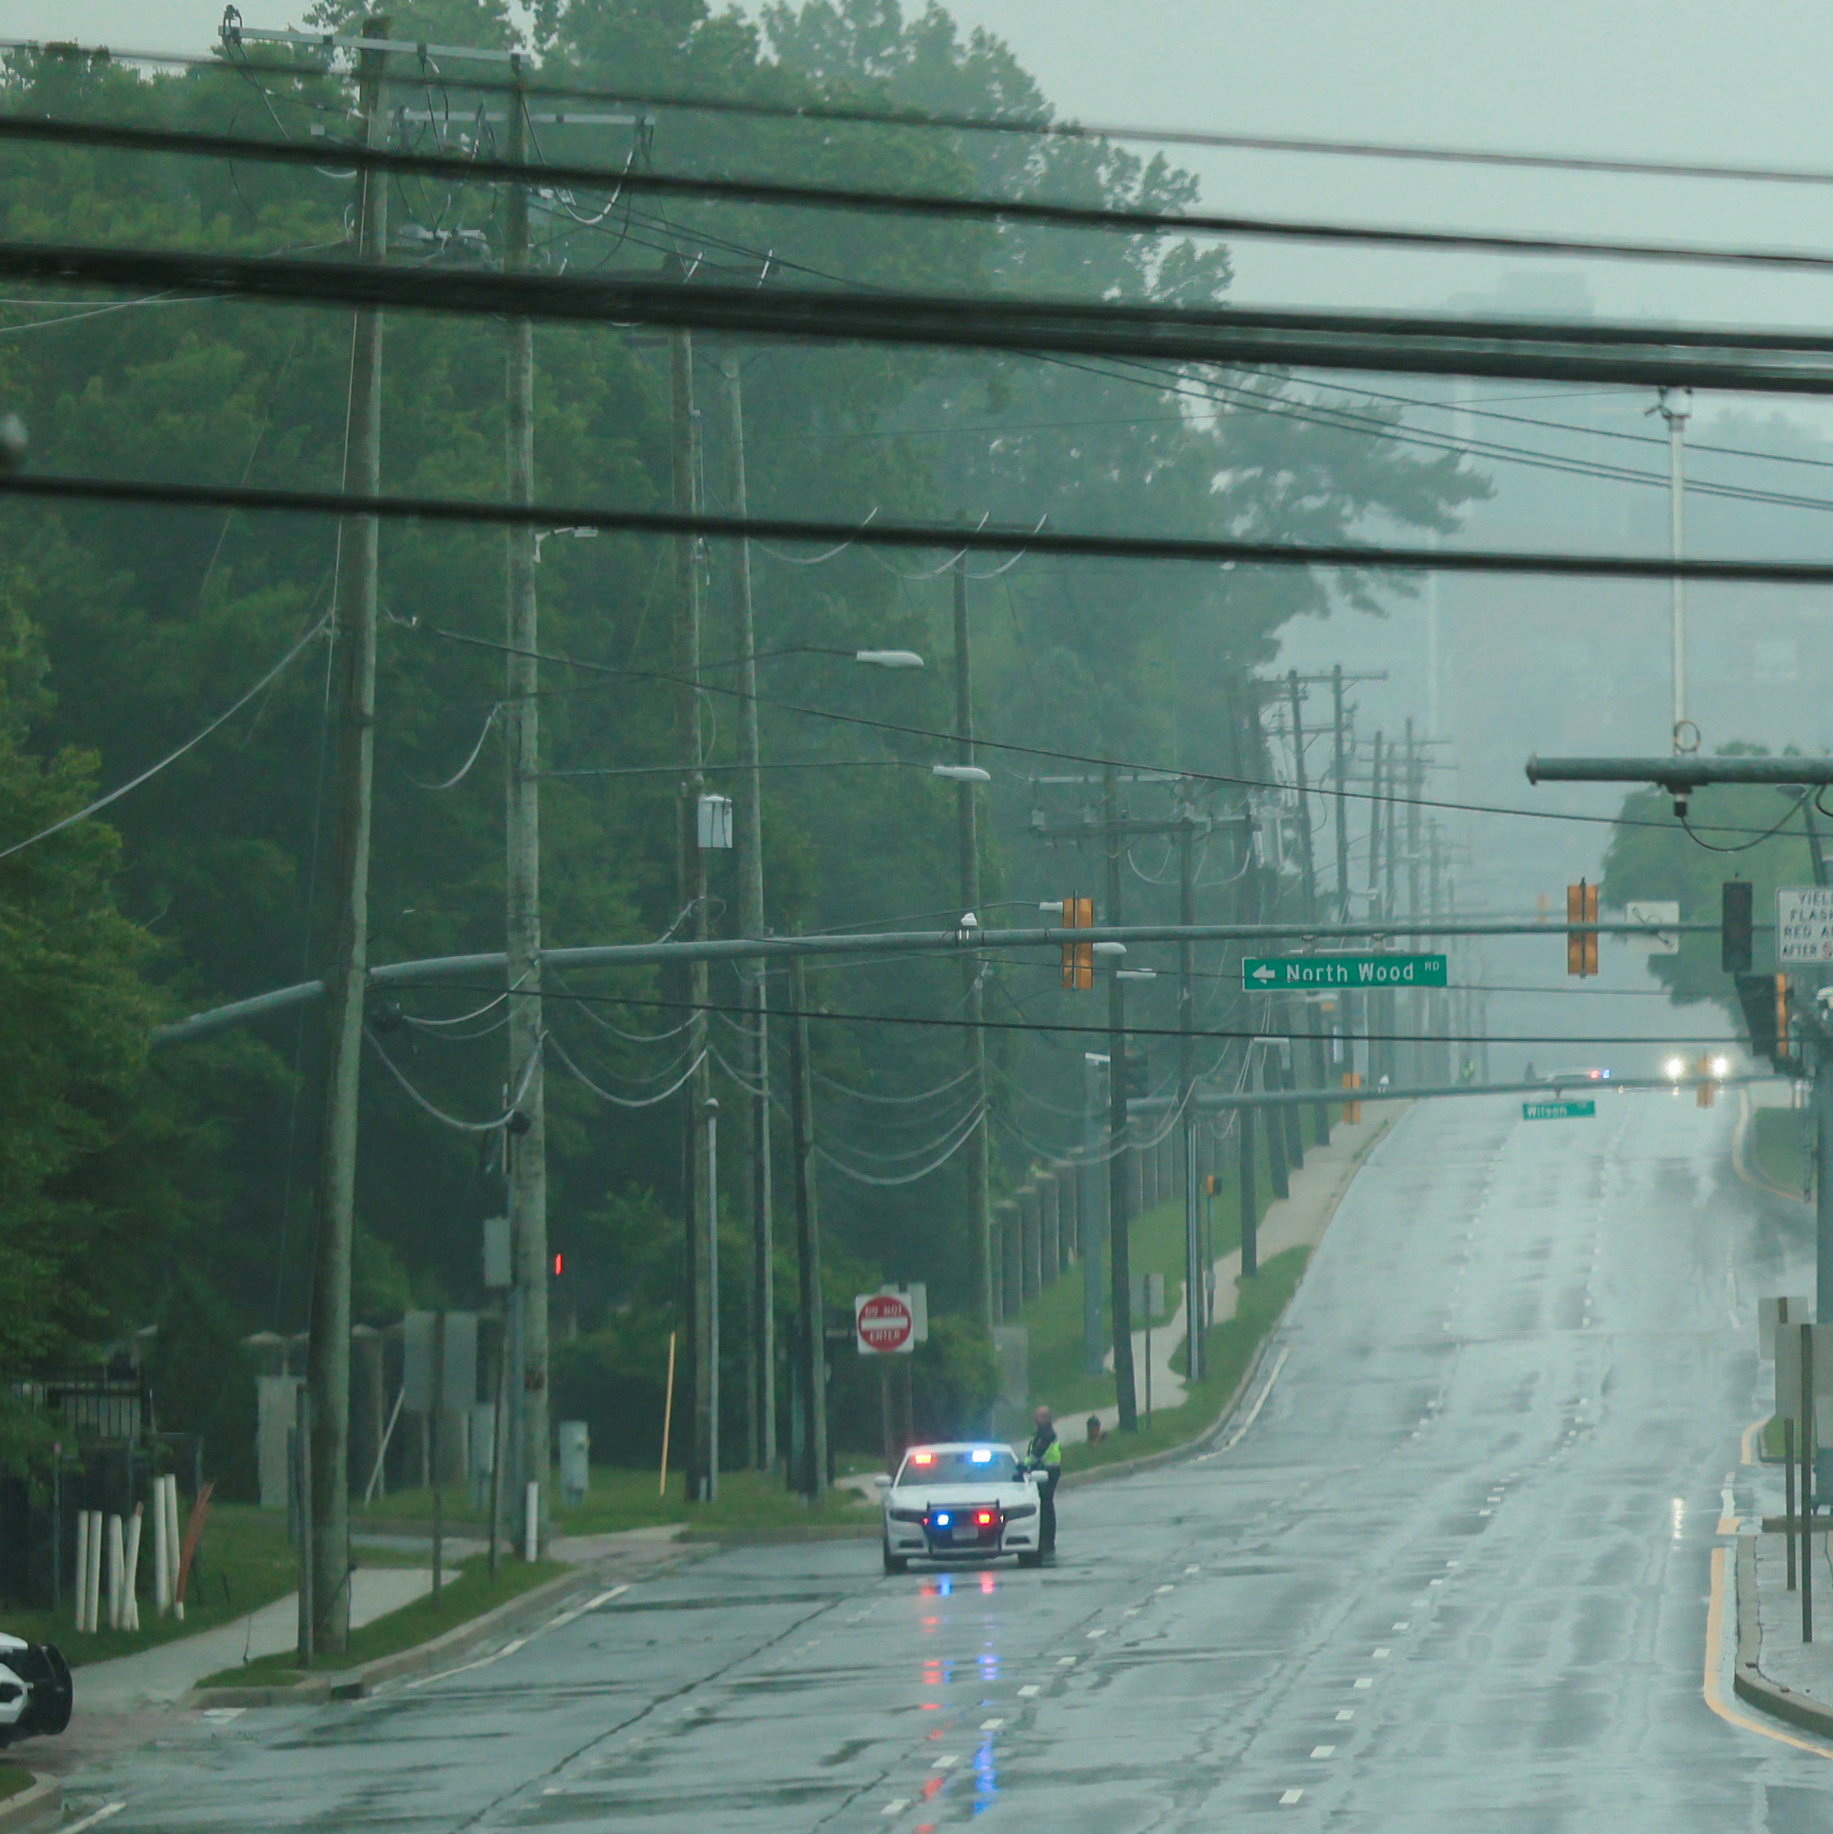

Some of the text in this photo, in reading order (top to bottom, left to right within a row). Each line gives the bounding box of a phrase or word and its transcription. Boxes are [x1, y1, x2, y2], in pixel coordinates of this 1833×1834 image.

[1784, 924, 1812, 939] RED
[1286, 961, 1440, 983] North Wood RD
[1526, 1104, 1568, 1119] Wilson
